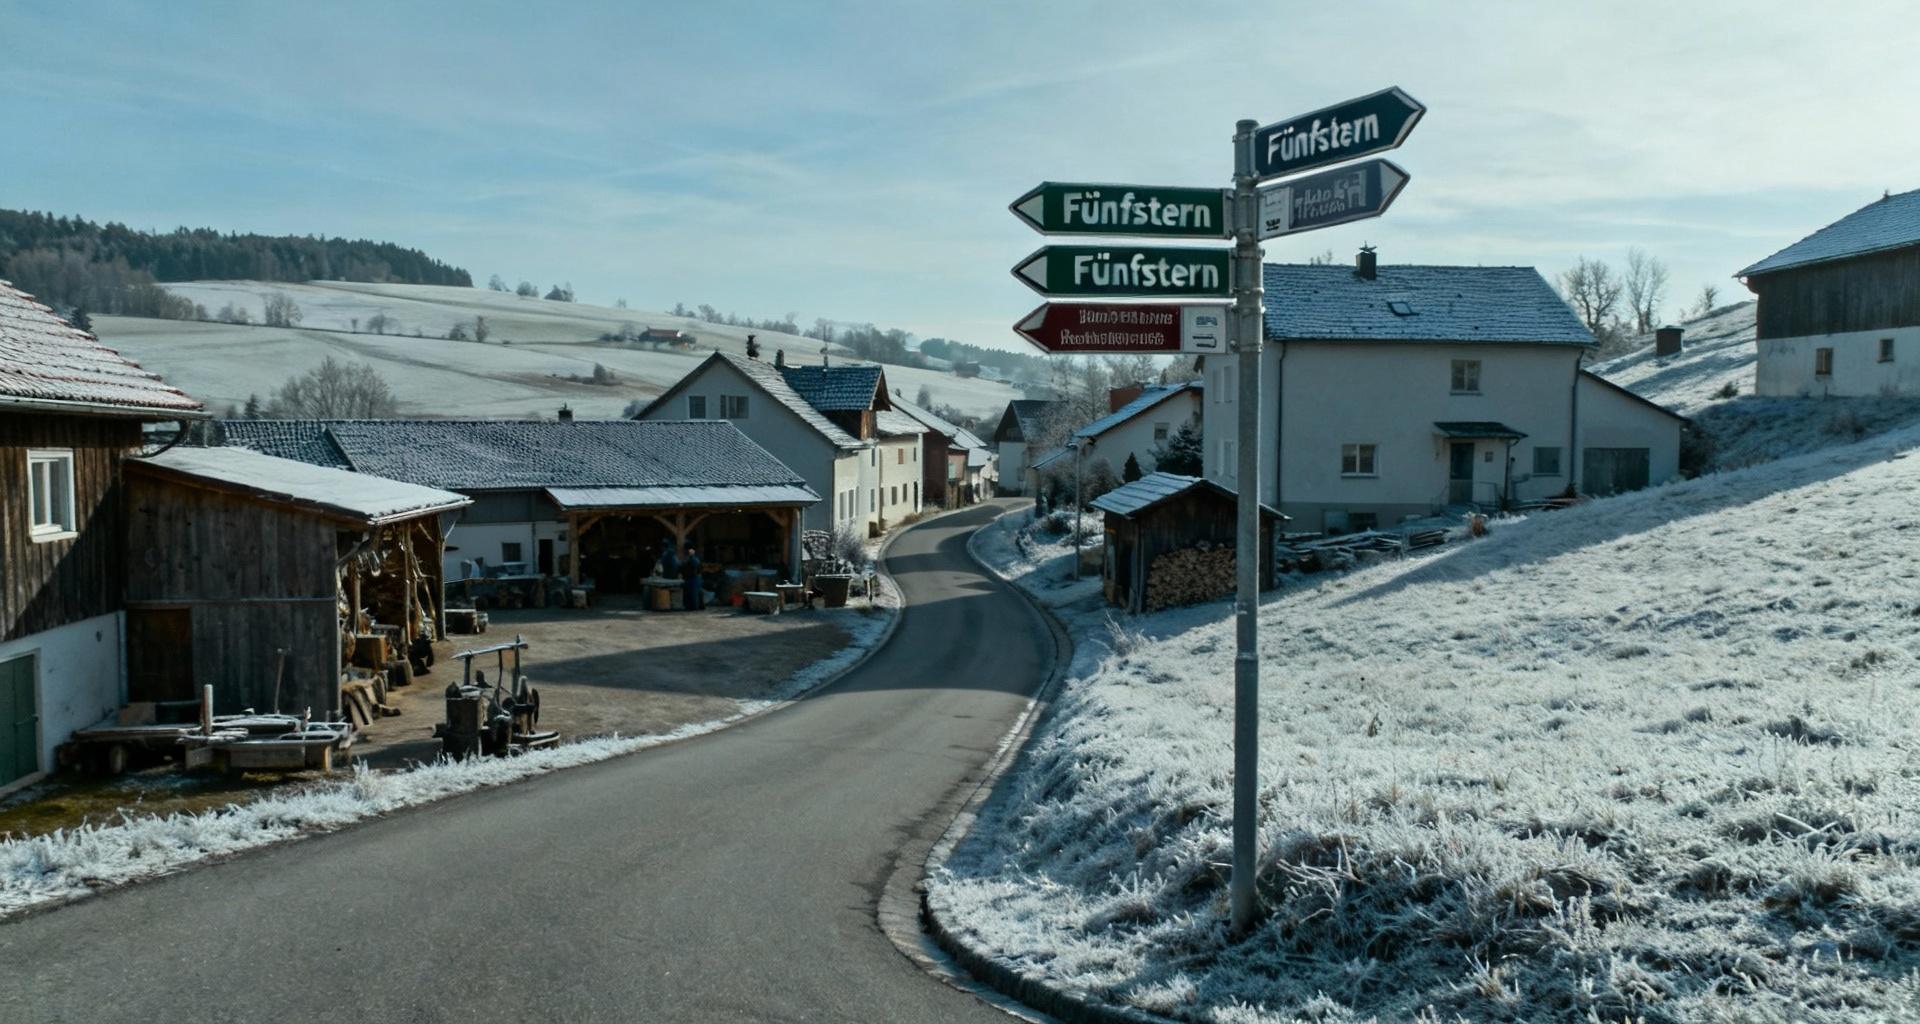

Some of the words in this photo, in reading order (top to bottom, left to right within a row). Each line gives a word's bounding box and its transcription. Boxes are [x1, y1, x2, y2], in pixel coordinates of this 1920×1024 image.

[1267, 113, 1379, 165] Fünfstern
[1063, 191, 1211, 227] Fünfstern
[1074, 252, 1219, 288] Fünfstern
